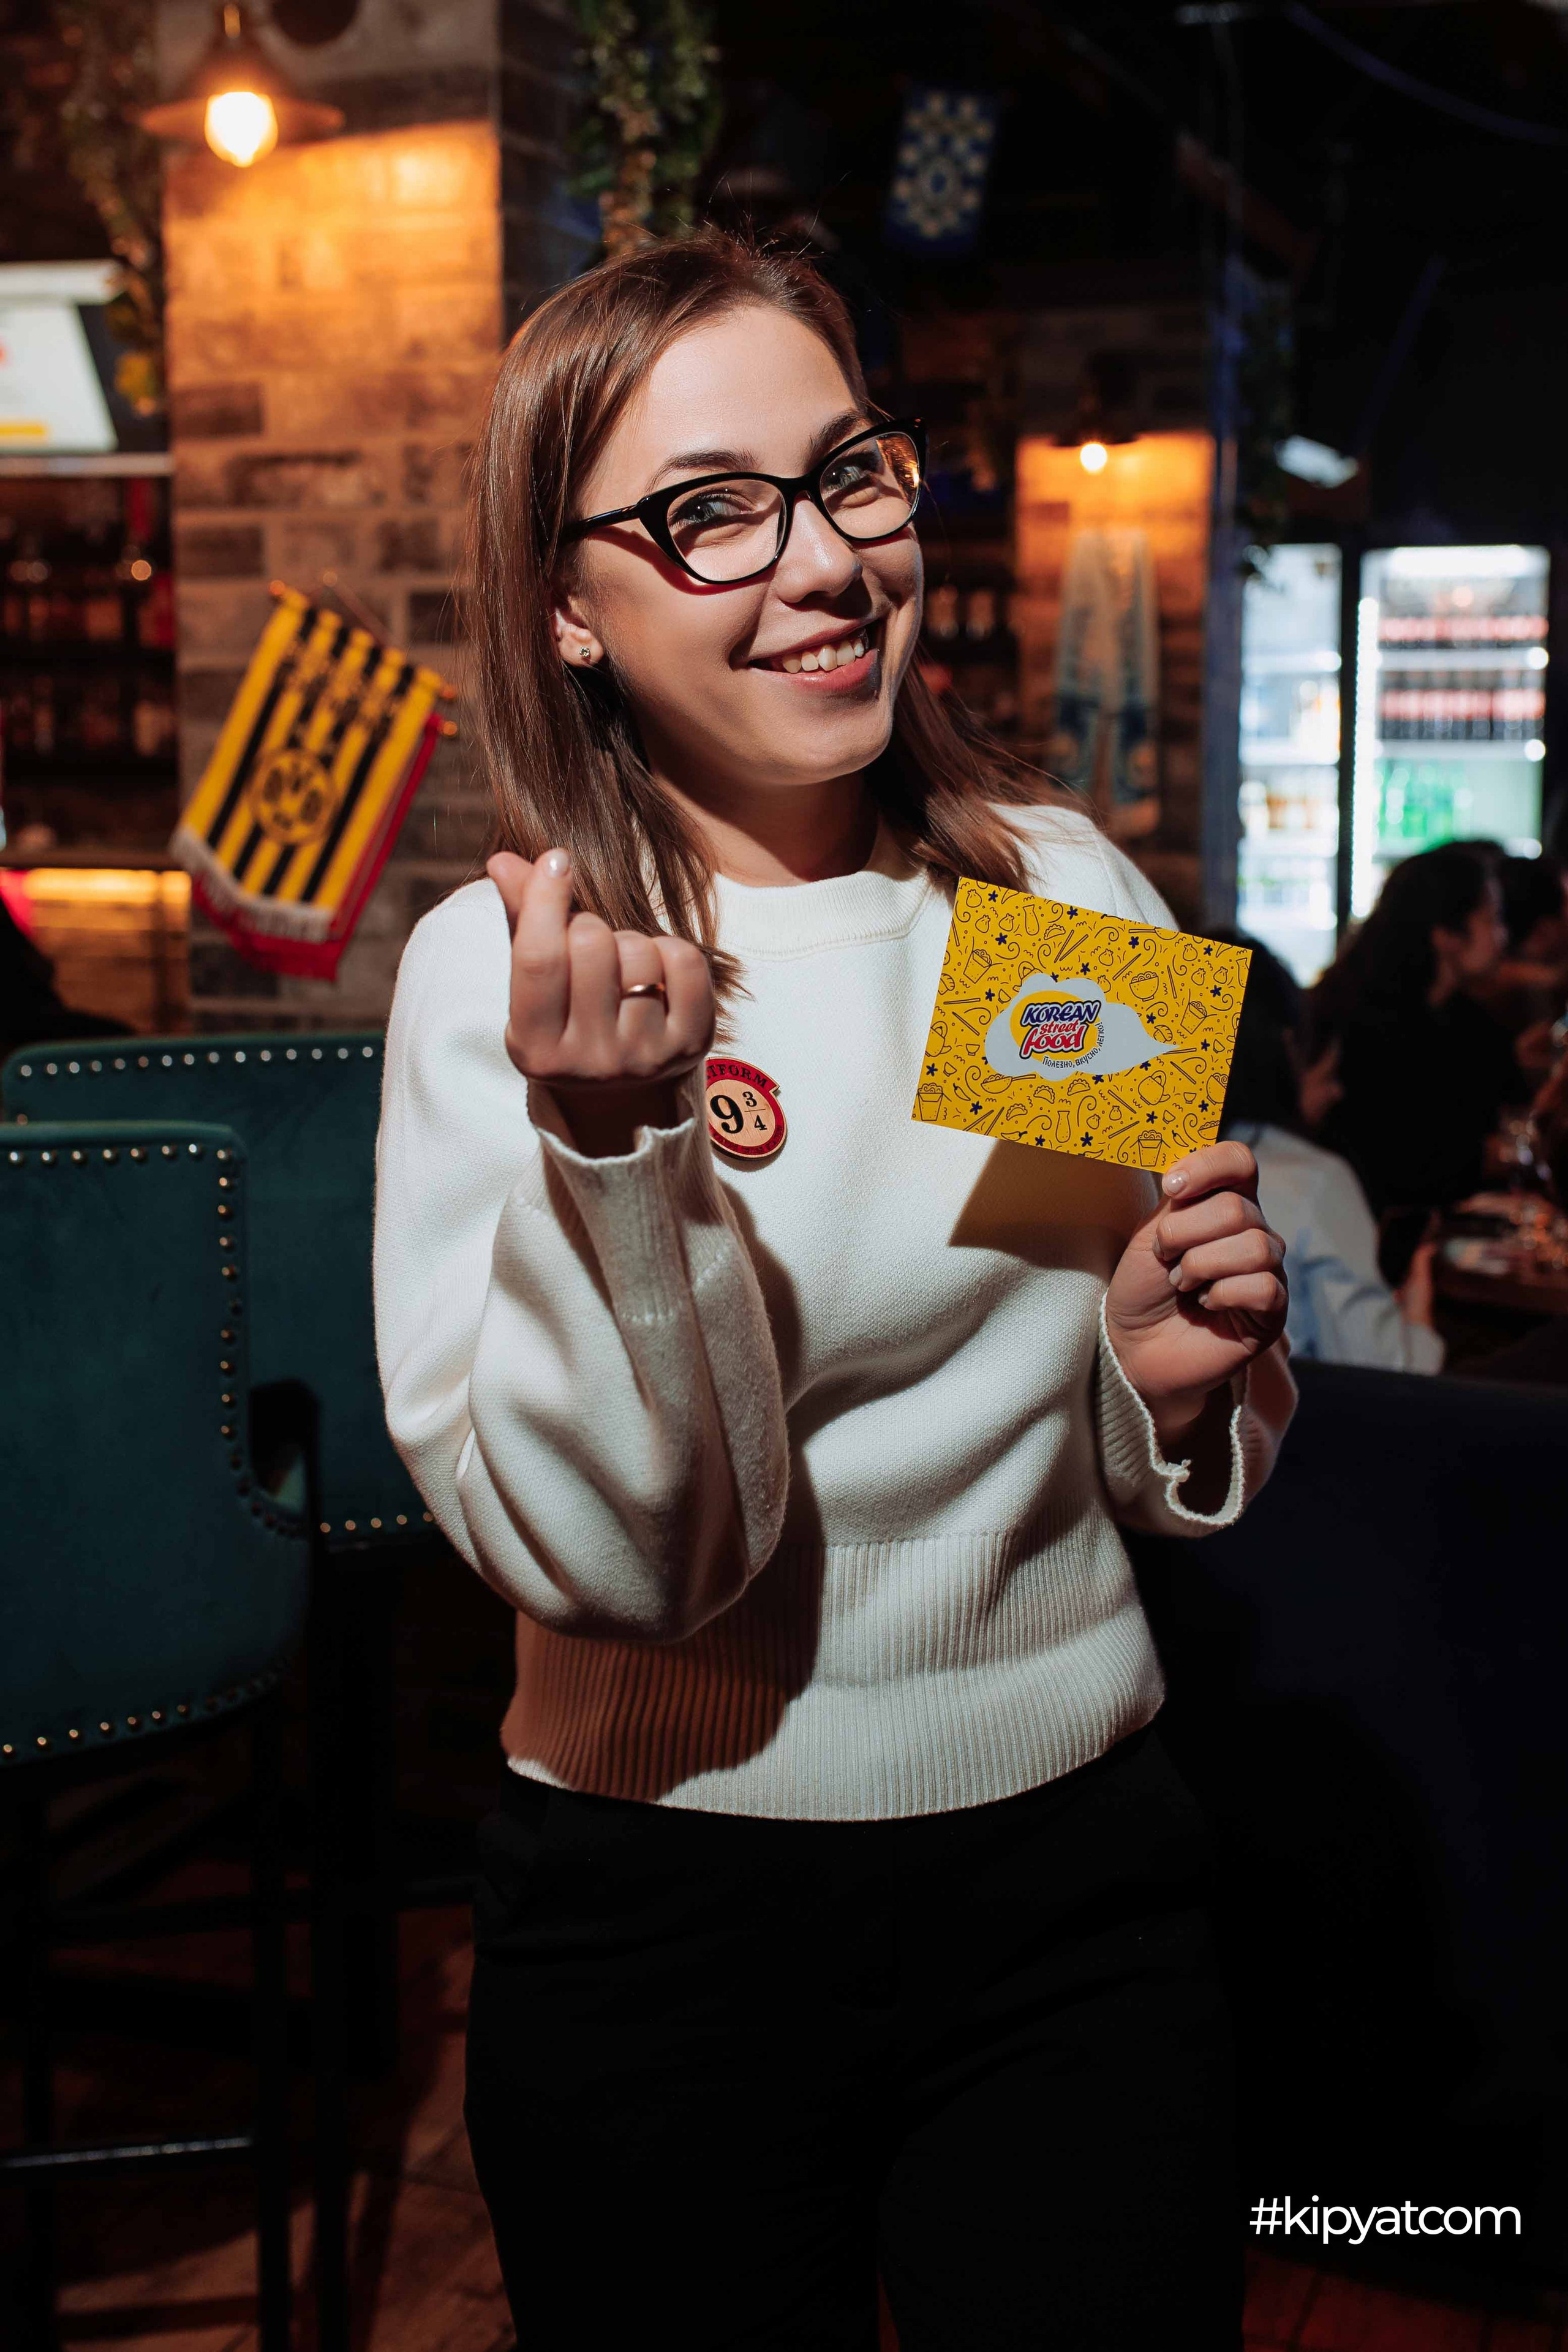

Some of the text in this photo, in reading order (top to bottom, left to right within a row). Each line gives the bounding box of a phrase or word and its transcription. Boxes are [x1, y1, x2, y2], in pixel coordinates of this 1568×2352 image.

[1023, 1003, 1099, 1025] KOREAN
[1039, 1019, 1079, 1035] street
[1023, 1025, 1085, 1055] food
[706, 1063, 767, 1088] TFORM
